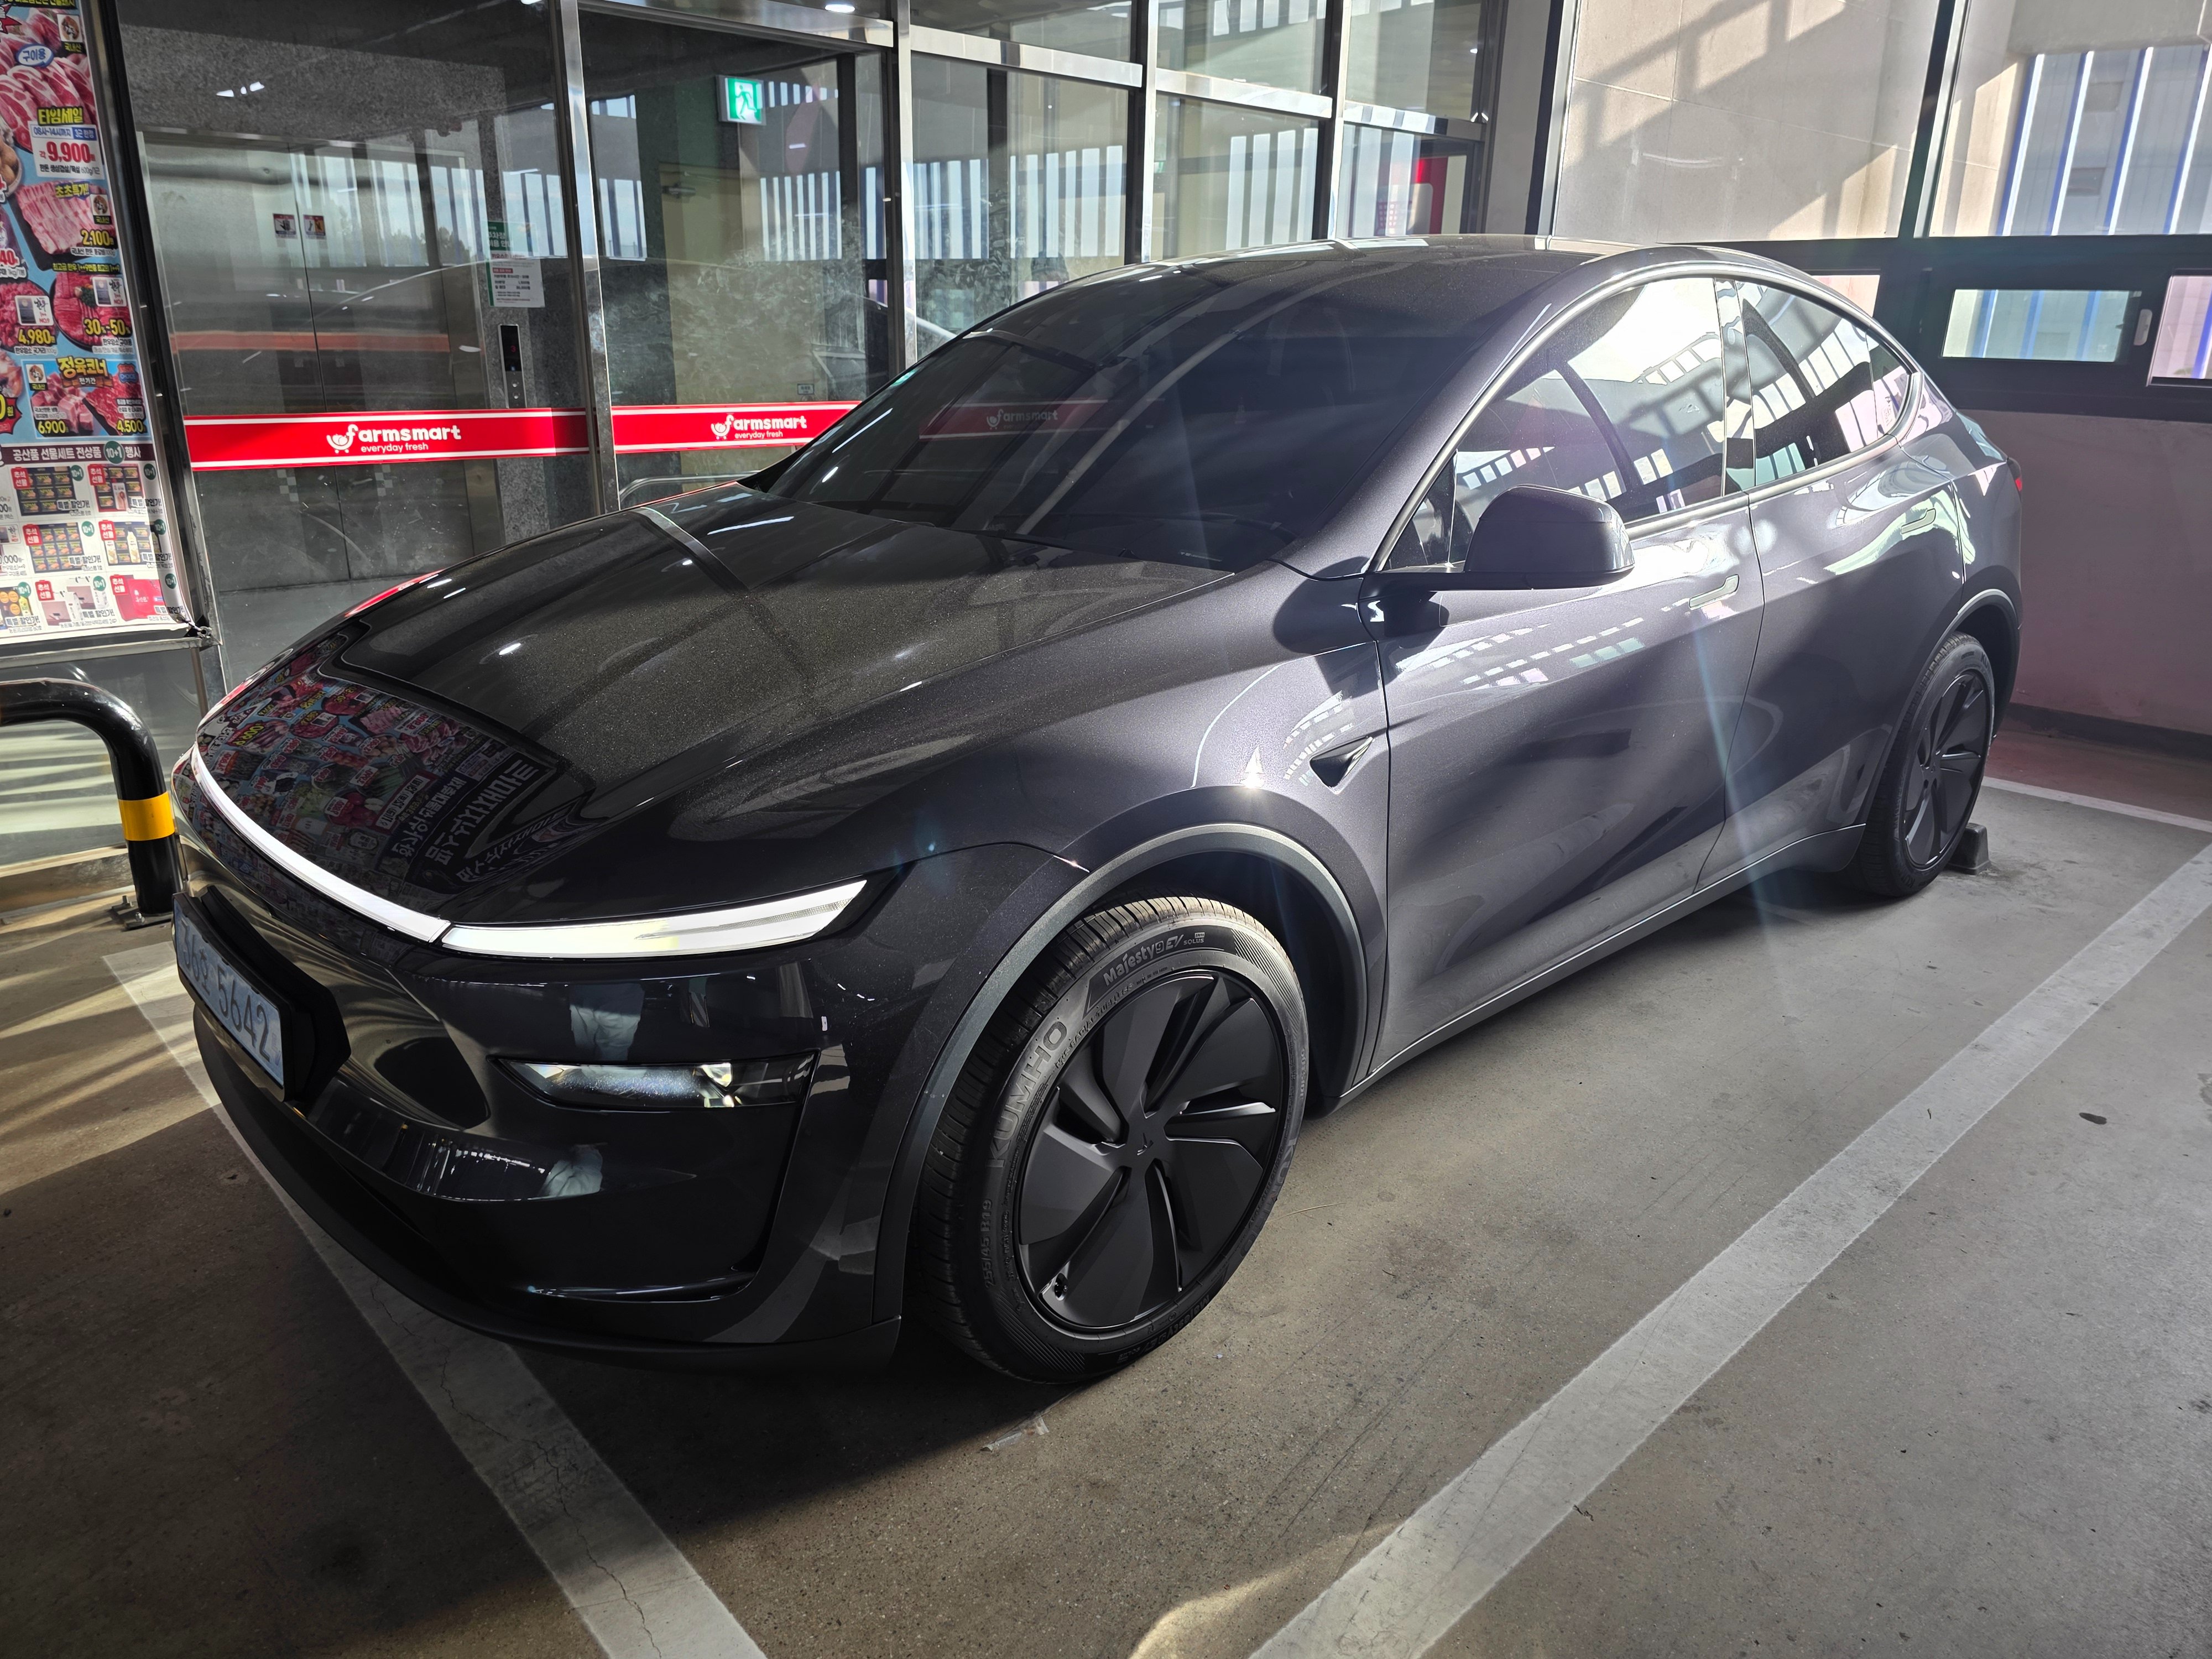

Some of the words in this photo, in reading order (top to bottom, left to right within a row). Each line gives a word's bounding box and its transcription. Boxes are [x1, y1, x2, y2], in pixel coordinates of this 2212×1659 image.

[23, 48, 46, 61] 구이용
[38, 107, 84, 125] 타임세일
[58, 356, 108, 379] 정육코너
[725, 414, 807, 431] farmsmart
[346, 424, 462, 443] farmsmart
[734, 431, 765, 440] everyday
[13, 448, 39, 462] 공산품
[41, 447, 75, 461] 선물세트
[76, 446, 102, 460] 전상품
[106, 446, 123, 459] 10+1
[124, 446, 141, 458] 행사
[361, 444, 403, 453] everyday
[405, 442, 429, 451] fresh
[217, 966, 270, 1063] 5642
[1070, 1018, 1094, 1047] RADIAL
[986, 1021, 1067, 1168] KUMHO
[980, 1198, 993, 1233] R19
[980, 1235, 995, 1288] 255/45
